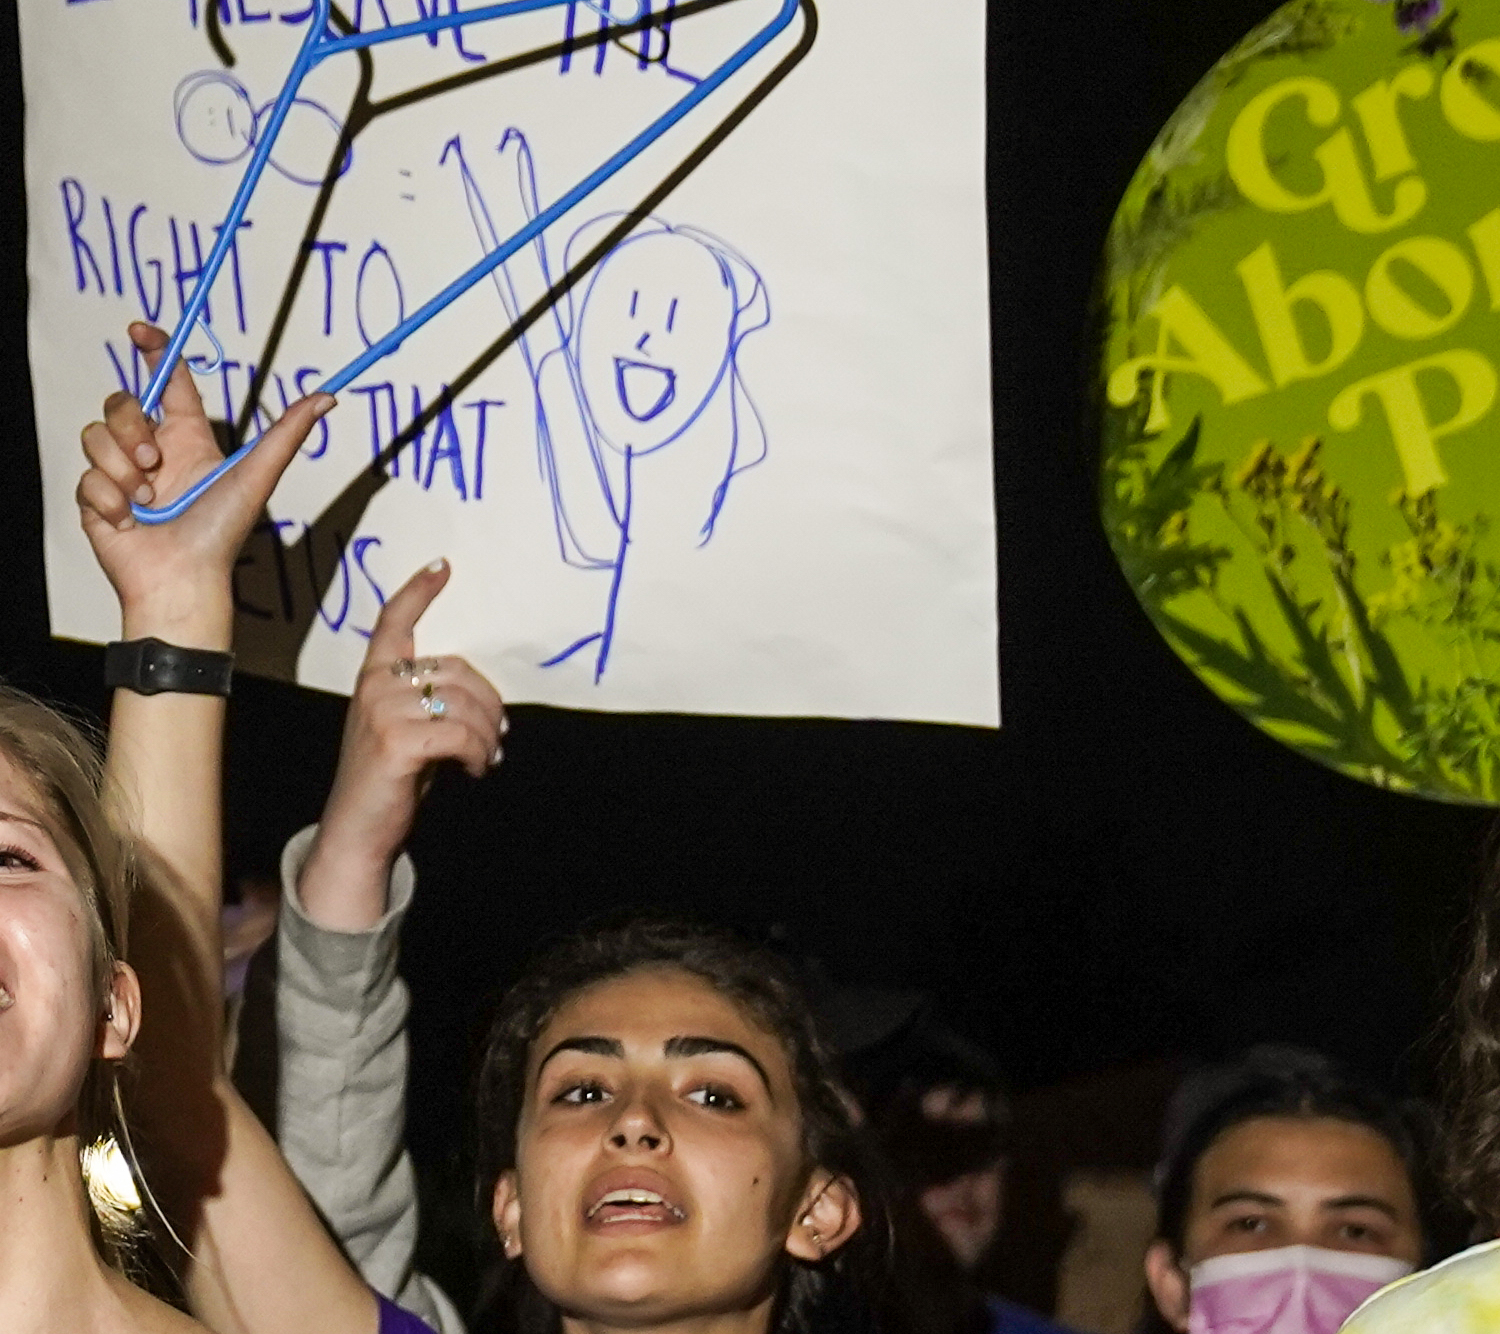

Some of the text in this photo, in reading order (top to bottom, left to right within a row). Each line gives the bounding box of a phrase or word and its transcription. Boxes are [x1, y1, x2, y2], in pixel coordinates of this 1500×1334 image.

[60, 177, 403, 357] RIGHT TO
[348, 381, 506, 502] THAT
